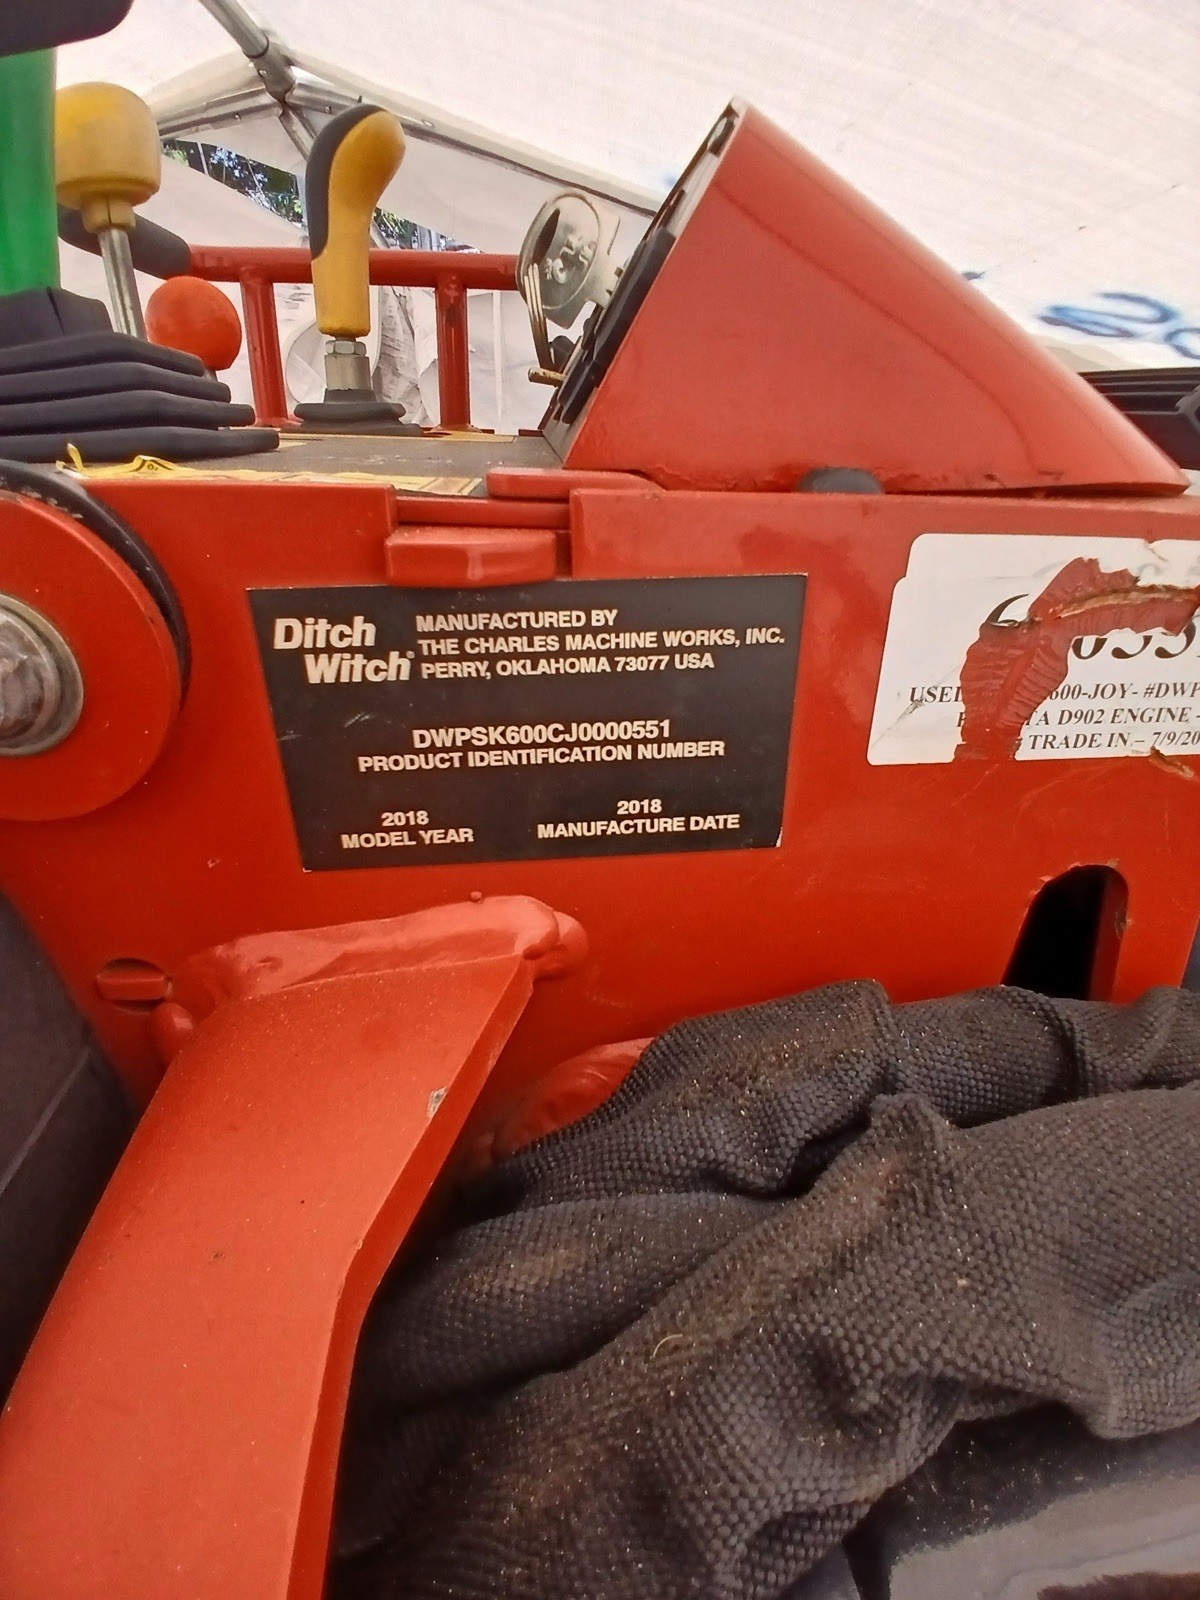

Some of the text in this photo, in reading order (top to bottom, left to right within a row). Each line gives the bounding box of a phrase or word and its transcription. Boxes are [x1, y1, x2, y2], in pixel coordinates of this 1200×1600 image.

[416, 609, 617, 632] MANUFACTURED BY
[274, 616, 376, 649] Ditch
[417, 627, 785, 655] THE CHARLES MACHINE WORKS, INC.
[421, 653, 714, 679] PERRY, OKLAHOMA 73077 USA
[1057, 709, 1105, 726] D902
[1110, 707, 1191, 724] ENGINE
[413, 720, 670, 749] DWPSK600CJ0000551
[1029, 733, 1102, 750] TRADE
[358, 741, 725, 772] PRODUCT IDENTIFICATION NUMBER
[617, 799, 662, 814] 2018
[381, 811, 429, 826] 2018
[538, 814, 740, 838] MANUFACTURE DATE
[341, 828, 474, 848] MODEL YEAR
